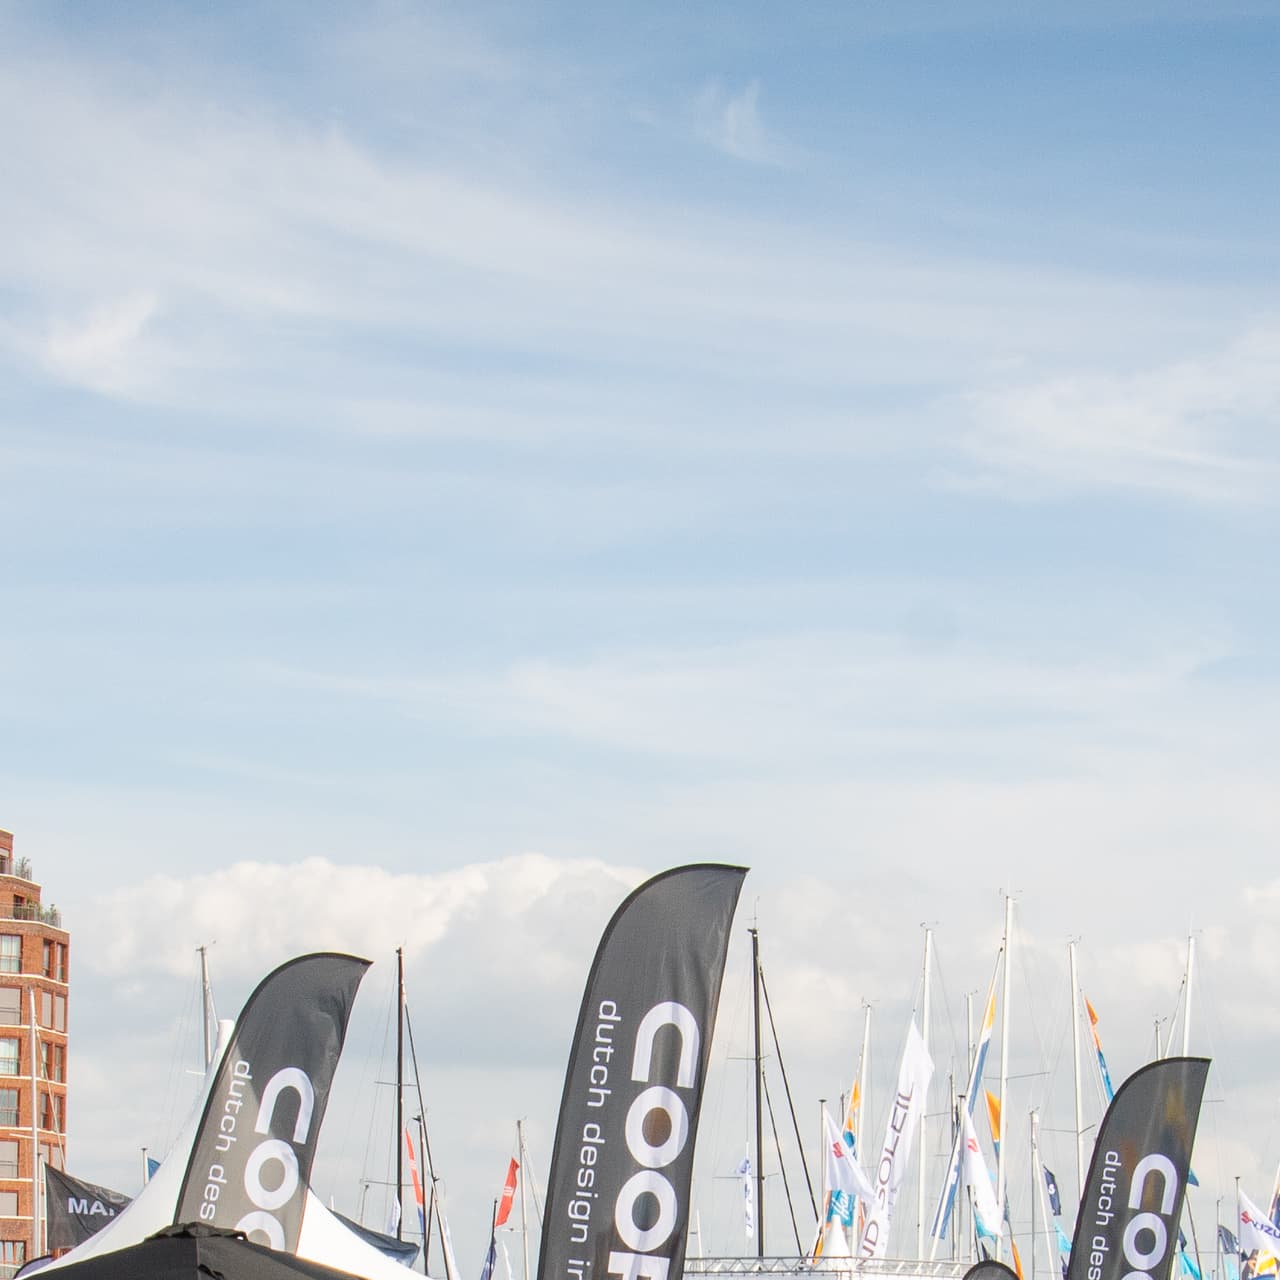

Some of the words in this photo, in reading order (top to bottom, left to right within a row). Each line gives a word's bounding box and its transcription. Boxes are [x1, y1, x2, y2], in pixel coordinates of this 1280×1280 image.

[587, 999, 621, 1108] dutch
[214, 1059, 252, 1151] dutch
[200, 1159, 230, 1222] des
[567, 1124, 604, 1244] design
[1095, 1150, 1122, 1226] dutch
